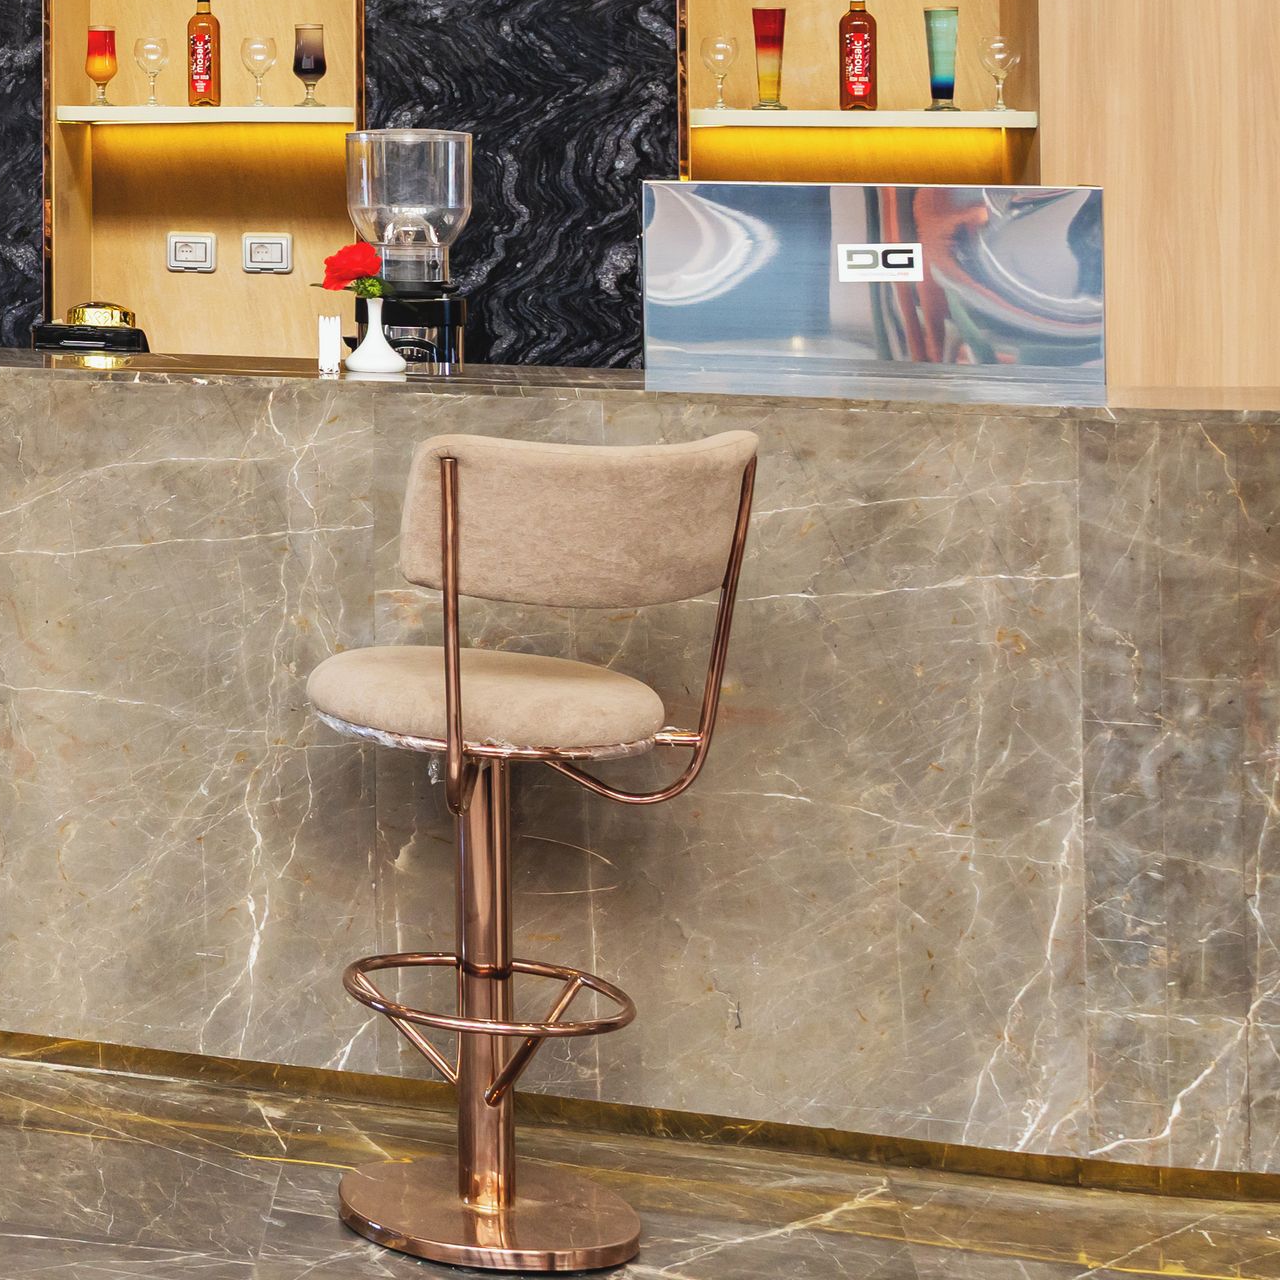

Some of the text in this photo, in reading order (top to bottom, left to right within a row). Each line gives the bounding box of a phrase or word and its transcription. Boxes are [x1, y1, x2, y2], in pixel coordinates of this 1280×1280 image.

[195, 41, 204, 73] mosaic
[852, 40, 863, 75] mosaic
[846, 249, 914, 269] DG
